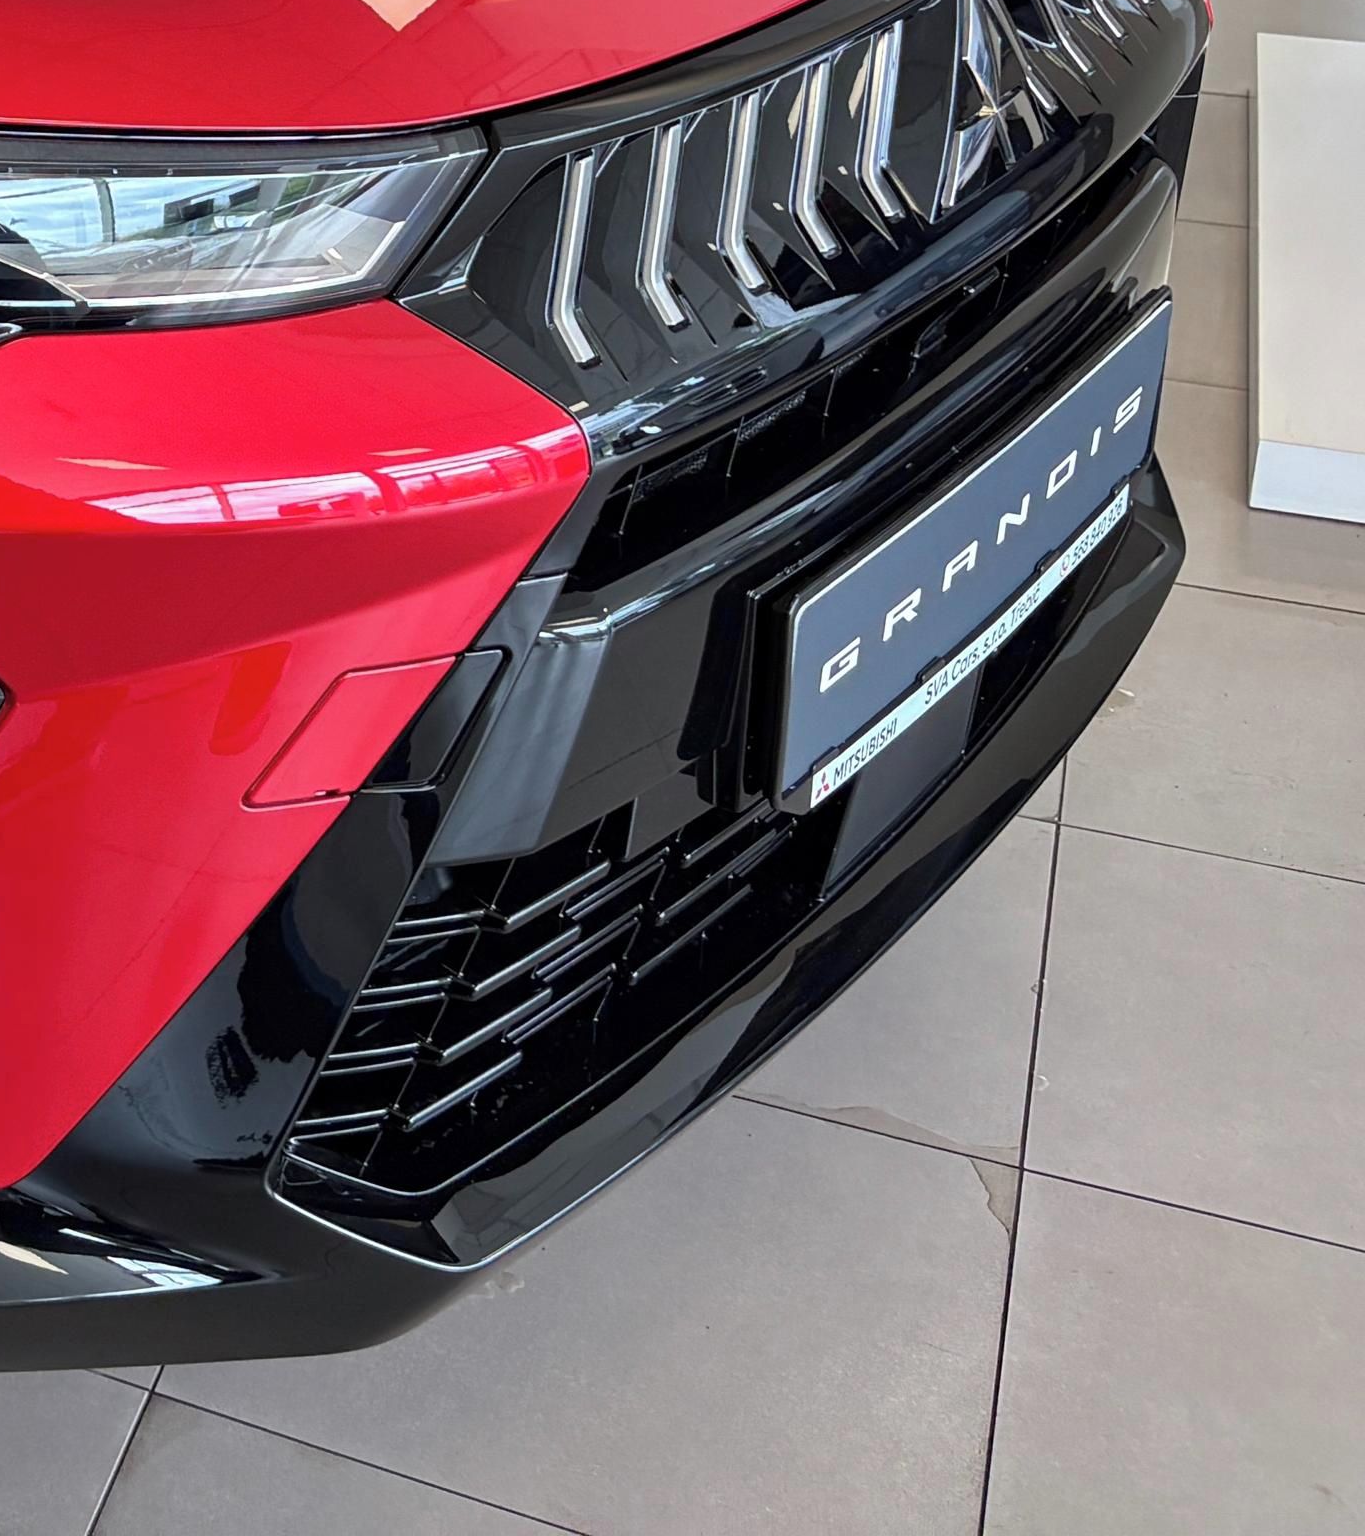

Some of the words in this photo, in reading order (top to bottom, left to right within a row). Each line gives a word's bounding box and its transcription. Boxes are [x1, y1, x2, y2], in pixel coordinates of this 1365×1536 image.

[820, 386, 1143, 693] GRANDIS
[833, 717, 898, 786] MITSUBISHI
[924, 670, 948, 705] SVA
[951, 647, 980, 681] Cars,
